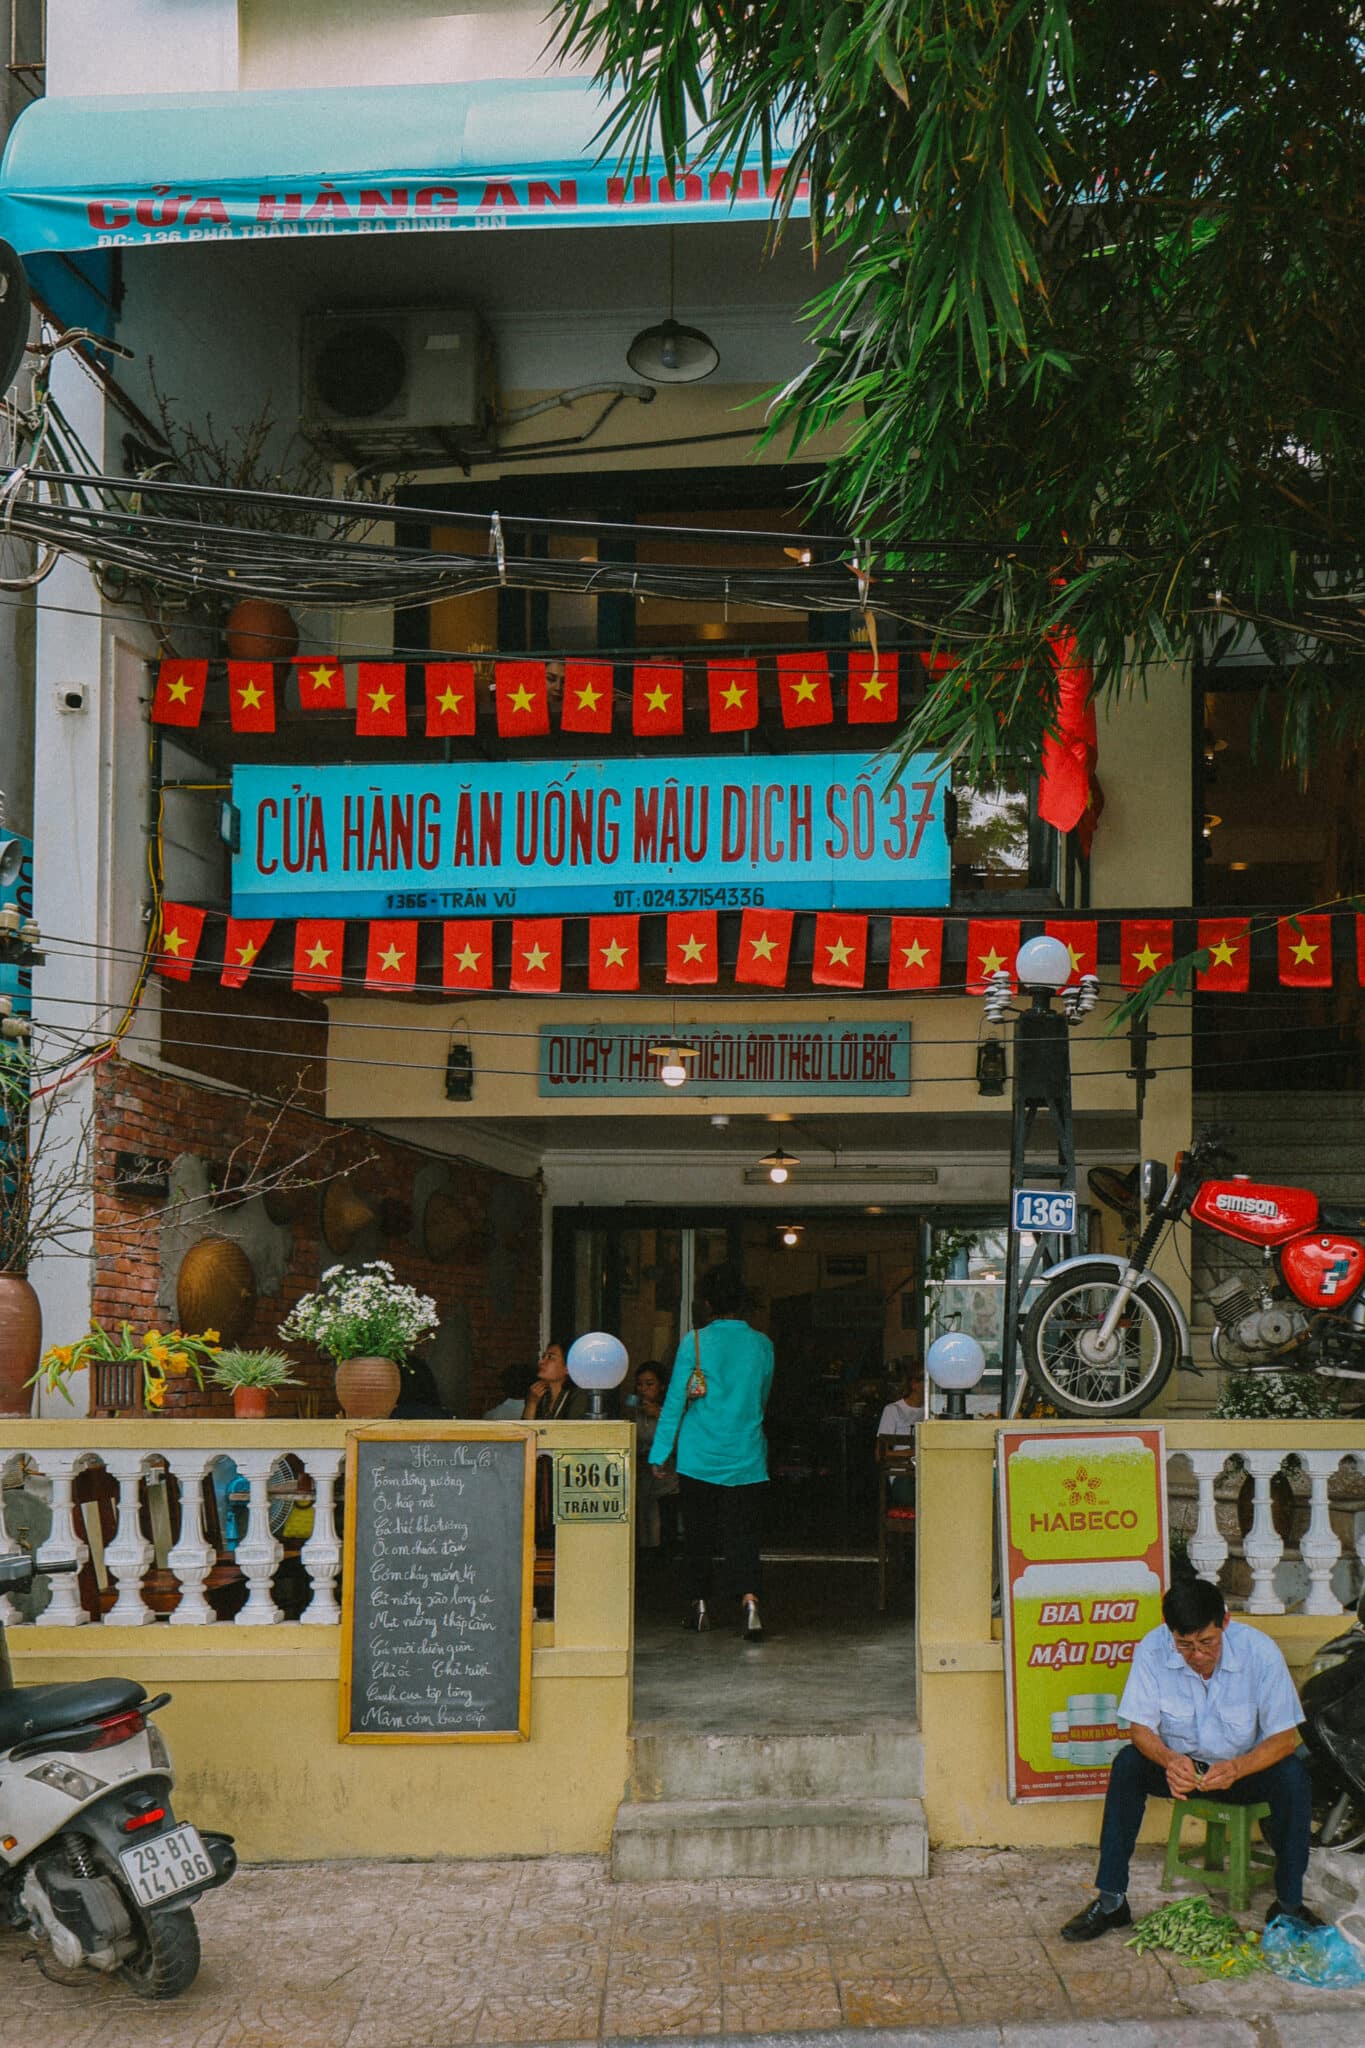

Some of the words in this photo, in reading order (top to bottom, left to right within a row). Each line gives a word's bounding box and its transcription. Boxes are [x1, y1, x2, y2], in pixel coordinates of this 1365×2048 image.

[87, 185, 231, 230] CỬA
[256, 182, 459, 222] HÀNG
[474, 177, 578, 214] ĂN
[256, 784, 328, 875] CỬA
[343, 786, 441, 871] HÀNG
[453, 783, 502, 867] ĂN
[516, 765, 621, 866] UỐNG
[633, 777, 710, 874] MẬU
[721, 784, 813, 869] DỊCH
[825, 766, 876, 860] SỐ
[884, 782, 936, 860] 37
[494, 887, 517, 908] VŨ
[778, 1033, 823, 1081] THEO
[862, 1030, 898, 1081] BÁC
[1030, 1509, 1138, 1533] HABECO
[1040, 1603, 1082, 1624] BIA
[1091, 1601, 1137, 1622] HƠI
[1029, 1640, 1088, 1669] MẬU
[1092, 1641, 1141, 1667] DỊC
